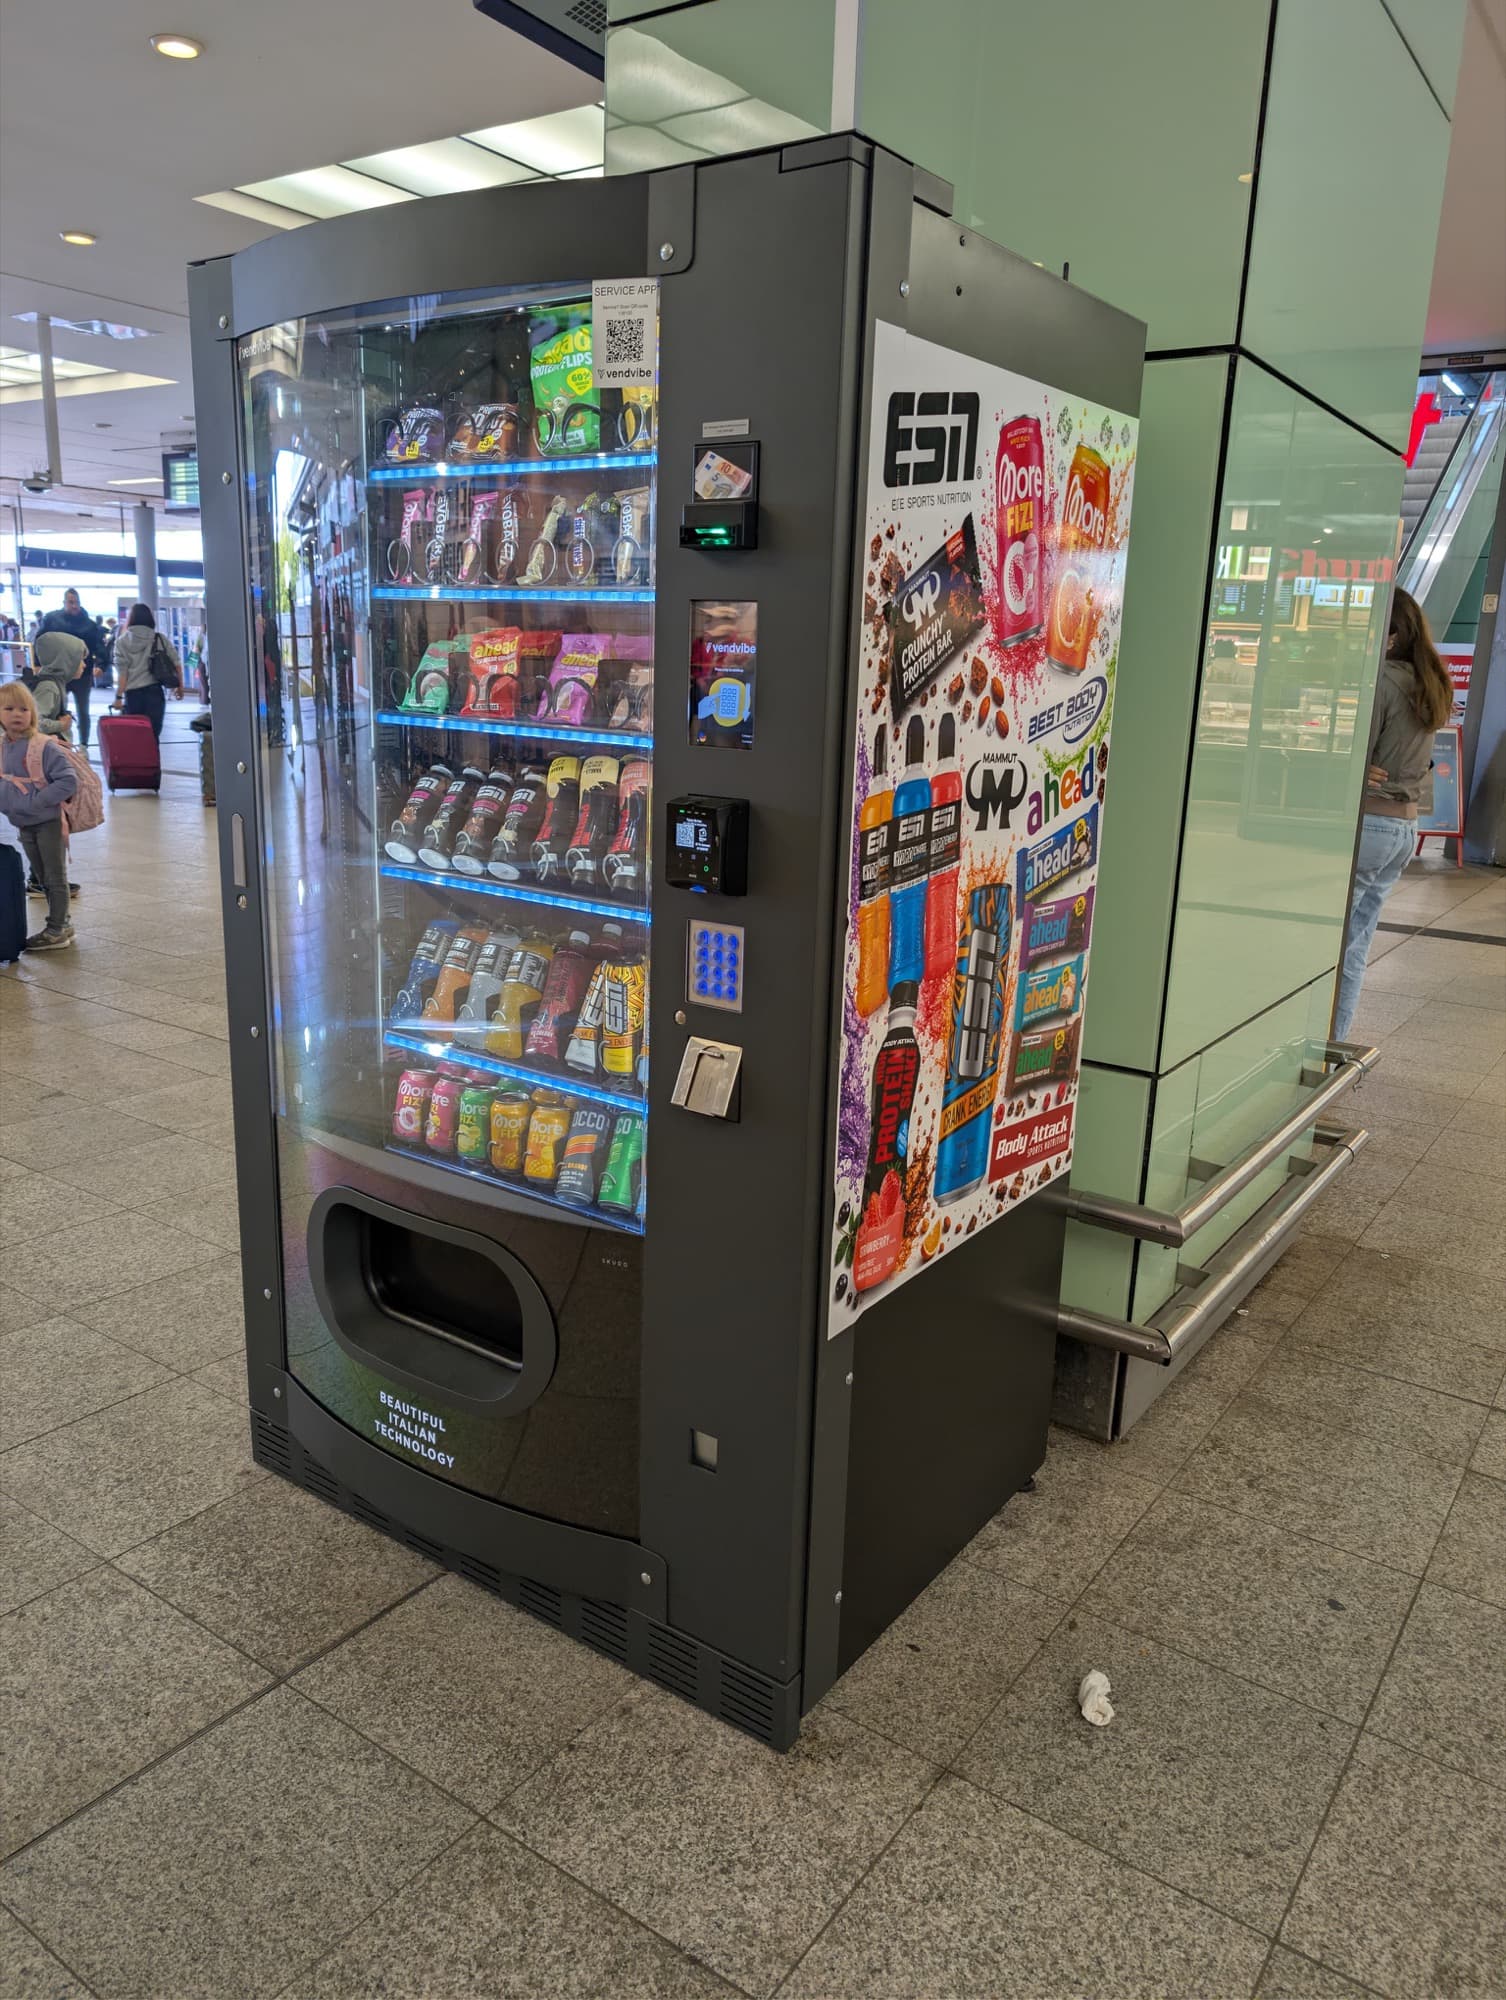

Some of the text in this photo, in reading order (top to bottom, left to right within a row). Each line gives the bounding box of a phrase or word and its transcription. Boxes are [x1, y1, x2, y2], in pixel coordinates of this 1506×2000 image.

[595, 285, 657, 297] SERVICE APP
[561, 352, 593, 370] FLIPS
[606, 368, 652, 378] vendvibe
[883, 391, 981, 488] ESN
[720, 462, 731, 474] 10
[998, 453, 1042, 509] More
[907, 495, 935, 509] SPORTS
[937, 491, 972, 505] NUTRITION
[1007, 501, 1034, 539] FIZ!
[474, 636, 519, 658] ahead
[713, 642, 757, 654] vendvibe
[901, 614, 944, 670] CRUNCHY
[902, 644, 936, 690] PROTEIN
[936, 628, 953, 656] BAR
[1028, 685, 1099, 738] BEST BODY
[1064, 710, 1095, 733] NUTRITION
[982, 753, 1018, 764] MAMMUT
[1027, 746, 1095, 836] ahead
[1025, 833, 1071, 892] ahead
[1028, 911, 1069, 949] ahead
[1023, 975, 1061, 1014] ahead
[883, 1039, 898, 1048] BODY
[1016, 1040, 1054, 1075] ahead
[900, 1047, 917, 1110] SHAKE
[874, 1047, 906, 1164] PROTEIN
[995, 1115, 1069, 1161] Body Attack
[1027, 1133, 1067, 1158] SPORTS NUTRITION
[379, 1391, 446, 1433] BEAUTIFUL
[389, 1411, 436, 1445] ITALIAN
[374, 1419, 455, 1469] TECHNOLOGY
